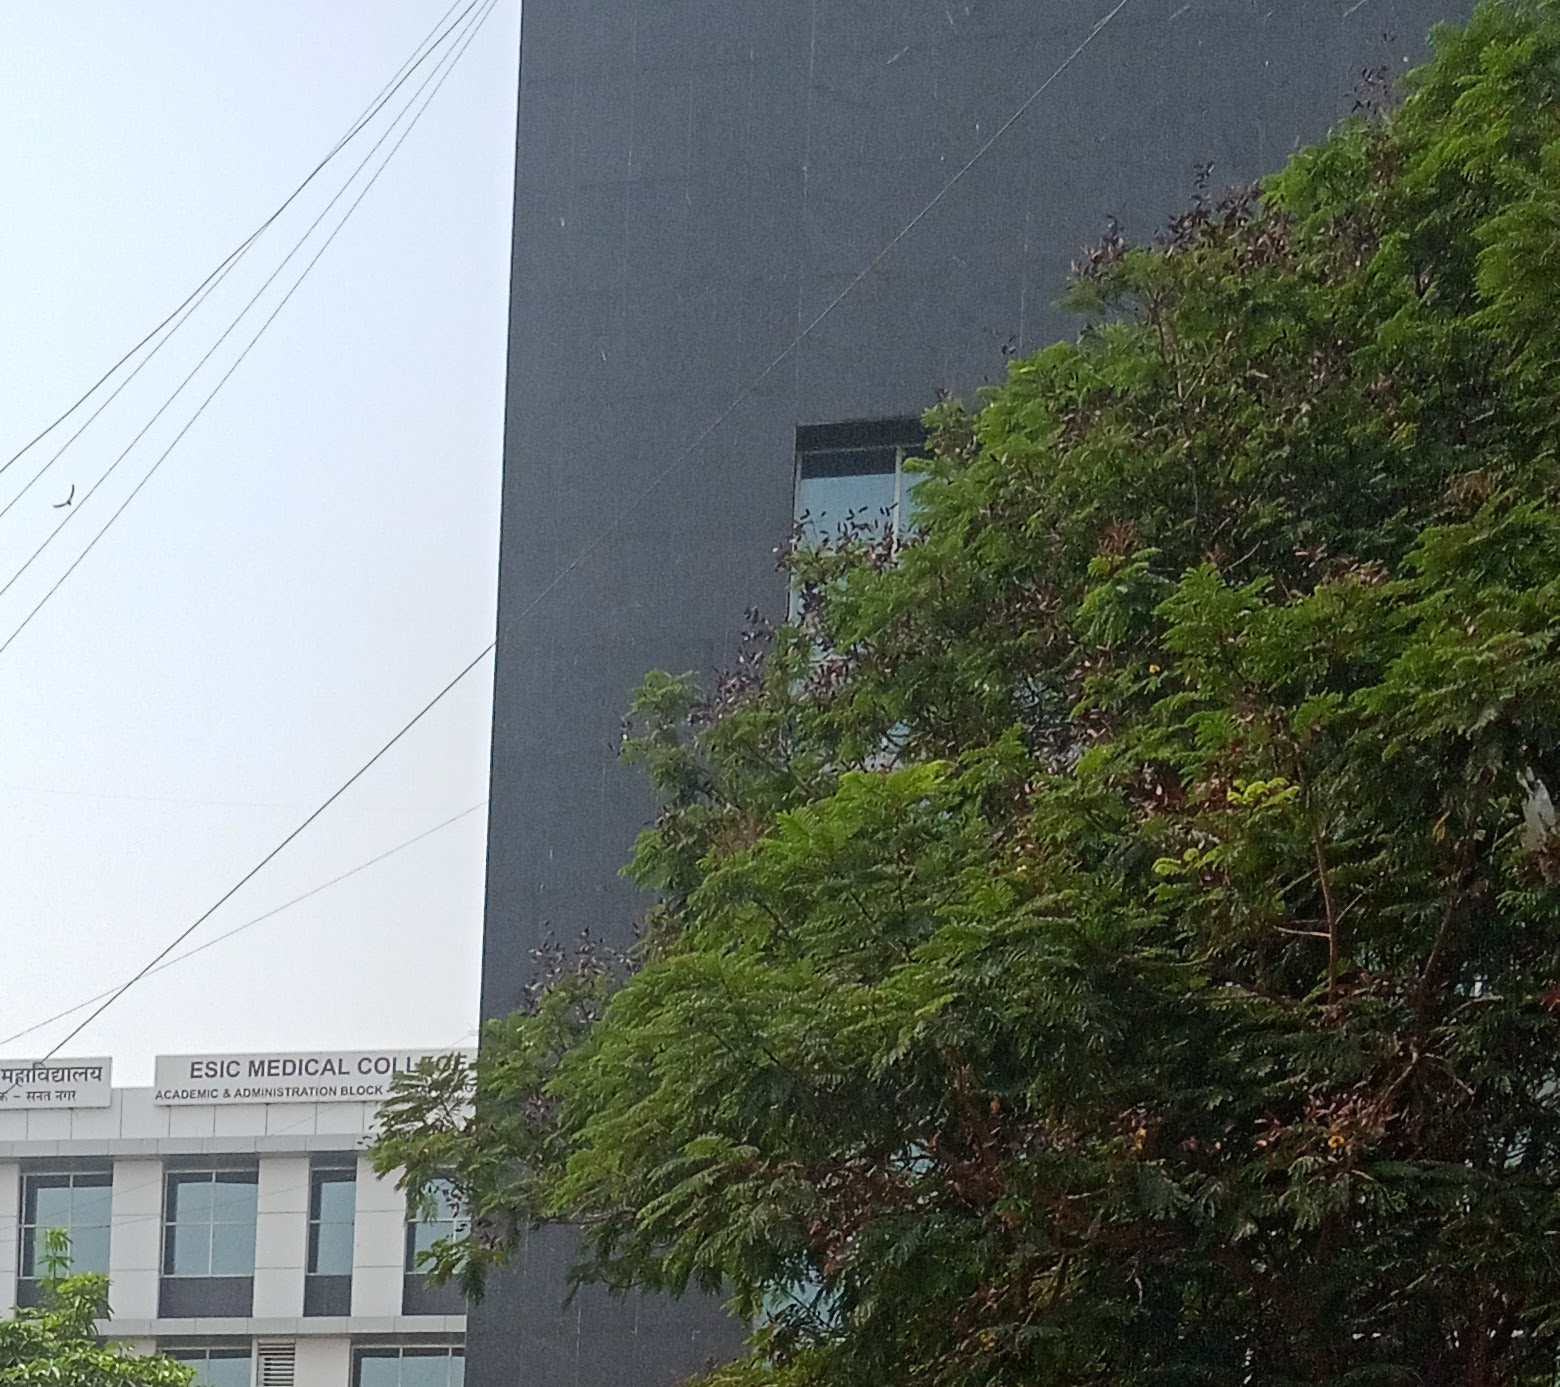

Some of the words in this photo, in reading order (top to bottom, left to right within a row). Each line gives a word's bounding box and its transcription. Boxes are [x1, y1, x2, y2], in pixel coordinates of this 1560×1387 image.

[1, 1061, 103, 1087] महाविद्यालय
[190, 1060, 241, 1079] ESIC
[248, 1057, 350, 1078] MEDICAL
[357, 1054, 467, 1076] COLLE
[155, 1088, 219, 1100] ACADEMIC
[223, 1088, 231, 1099] &
[234, 1085, 337, 1099] ADMINISTRATION
[341, 1085, 383, 1096] BLOCK
